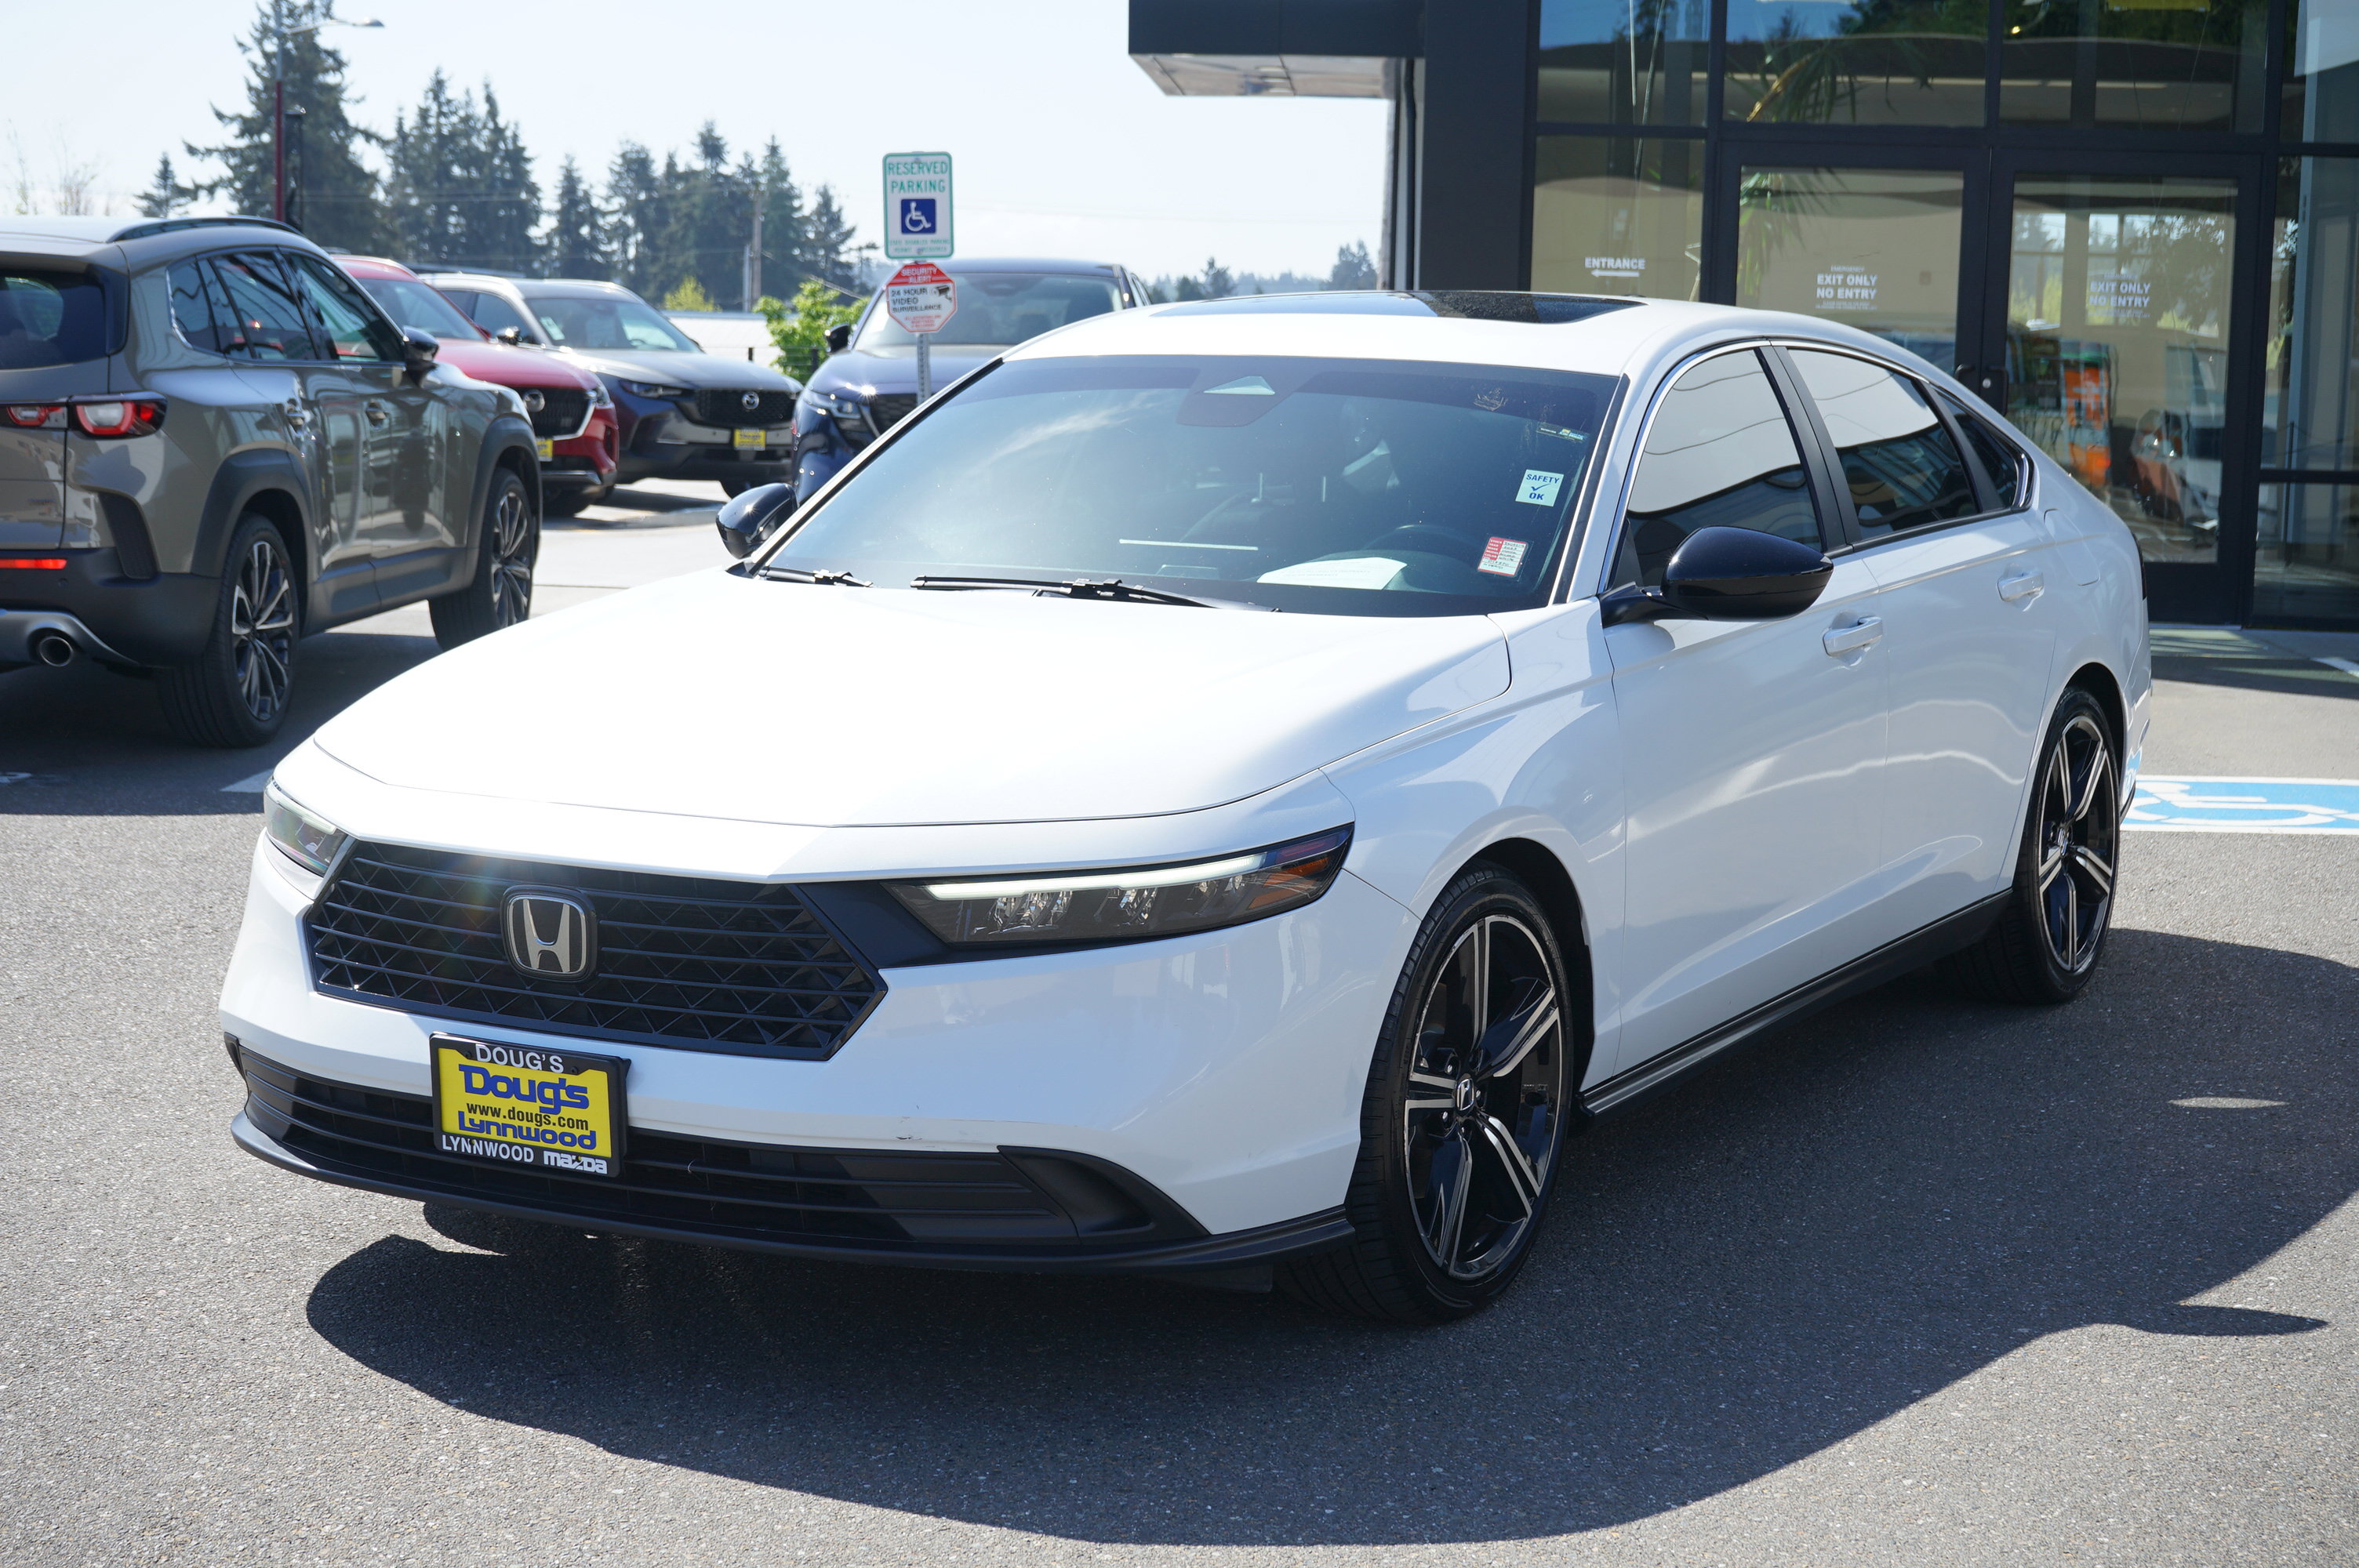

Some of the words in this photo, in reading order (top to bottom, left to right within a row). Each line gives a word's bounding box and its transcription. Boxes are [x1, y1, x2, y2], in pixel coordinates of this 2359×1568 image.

[888, 160, 948, 176] RESERVED
[891, 179, 946, 194] PARKING
[1585, 257, 1645, 270] ENTRANCE
[901, 267, 937, 276] SECURITY
[909, 274, 932, 283] ALERT
[1816, 274, 1844, 285] EXIT
[1846, 274, 1877, 286] ONLY
[903, 288, 928, 296] HOUR
[1816, 287, 1834, 299] NO
[1837, 288, 1877, 299] ENTRY
[2090, 281, 2117, 292] EXIT
[2120, 282, 2150, 294] ONLY
[892, 296, 918, 306] VIDEO
[2089, 295, 2106, 307] NO
[2110, 296, 2150, 307] ENTRY
[1526, 474, 1560, 484] SAFETY
[475, 1044, 565, 1074] DOUG'S
[458, 1063, 590, 1116] Doug's
[466, 1102, 589, 1131] www.dougs.com
[458, 1110, 597, 1150] Lynnwood
[442, 1134, 534, 1163] LYNNWOOD
